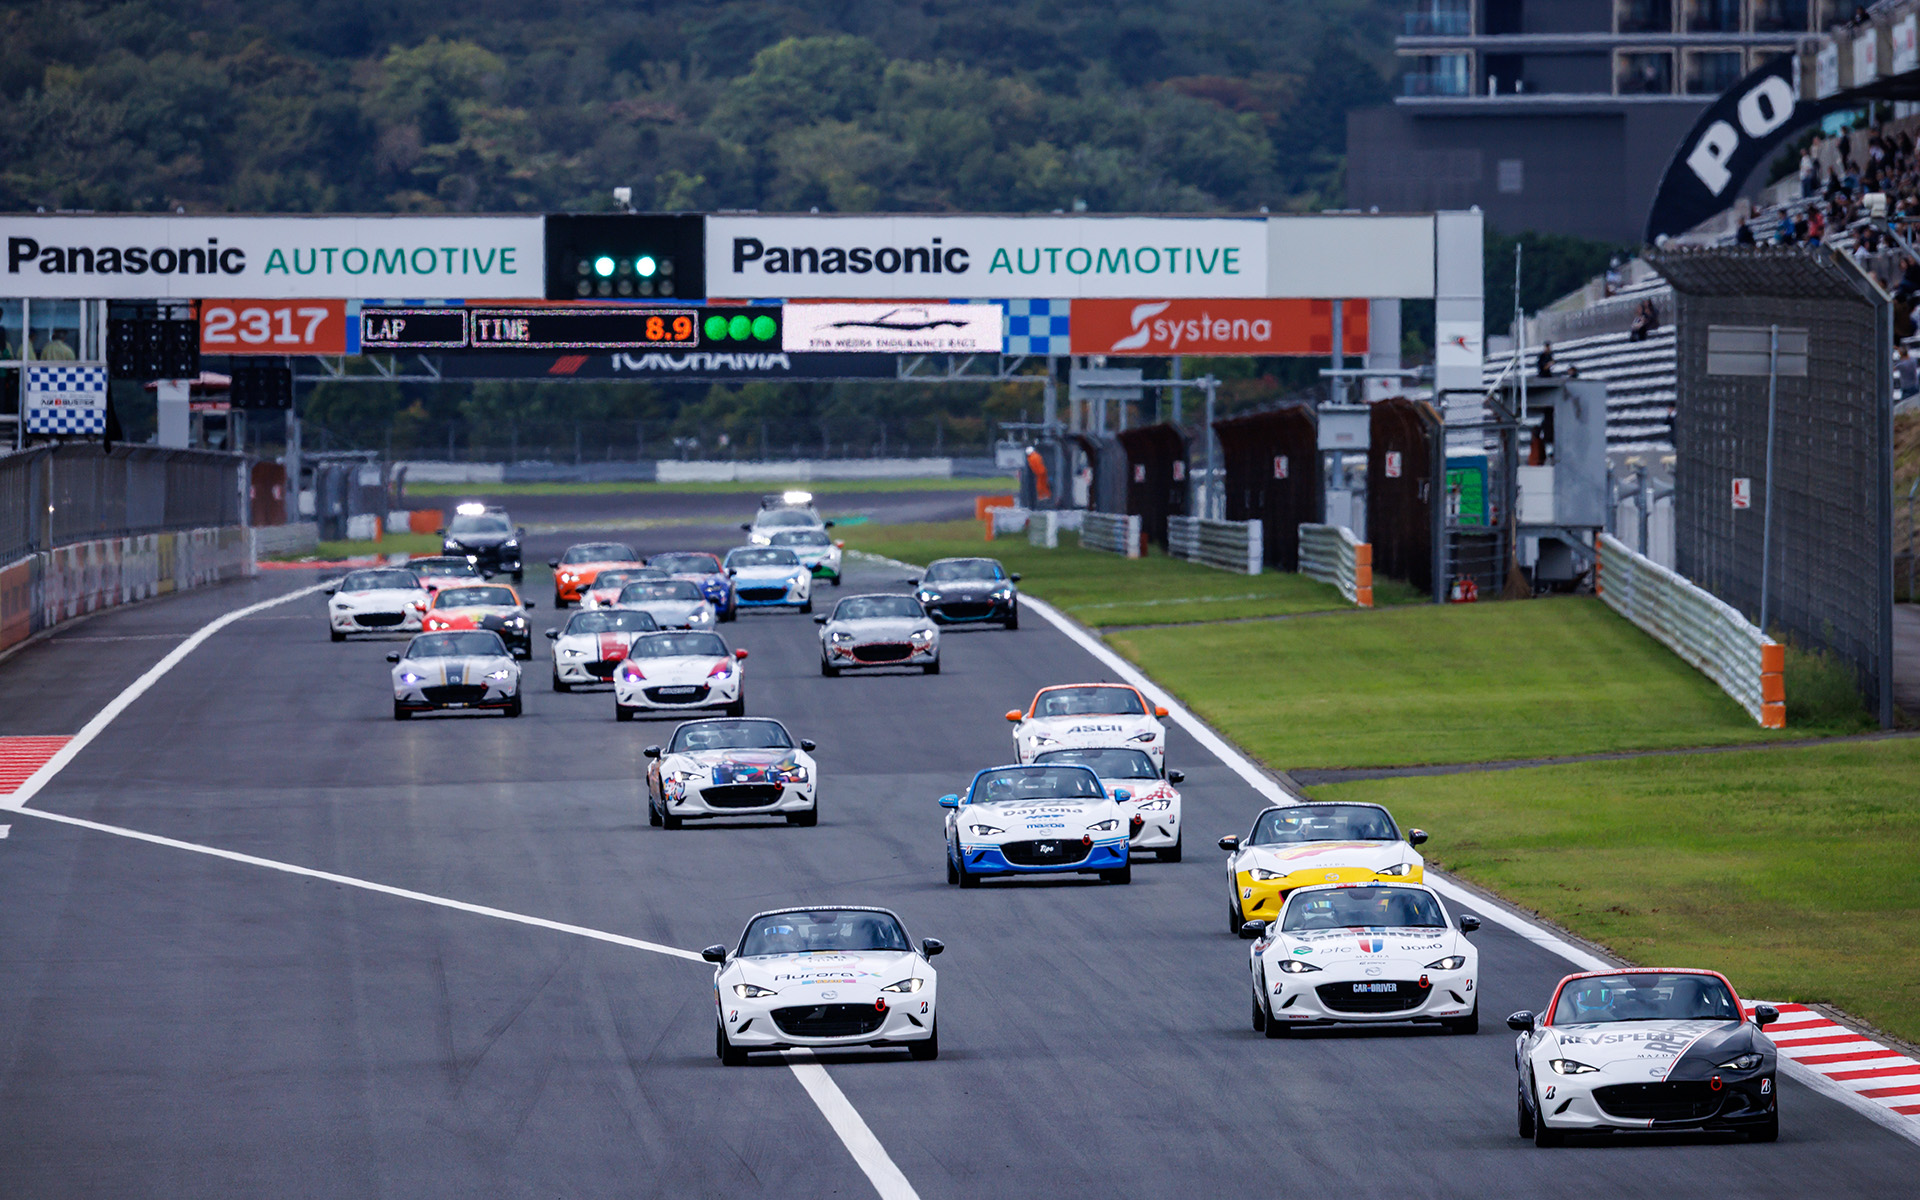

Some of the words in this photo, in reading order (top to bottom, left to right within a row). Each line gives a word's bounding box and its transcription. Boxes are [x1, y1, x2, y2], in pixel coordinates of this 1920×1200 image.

[8, 237, 247, 274] Panasonic
[264, 247, 518, 276] AUTOMOTIVE
[733, 237, 970, 274] Panasonic
[989, 246, 1241, 275] AUTOMOTIVE
[203, 307, 329, 344] 2317
[365, 317, 407, 341] LAP
[478, 317, 531, 341] TIME
[645, 316, 692, 341] 8.9
[1153, 311, 1273, 350] systena
[1067, 724, 1123, 734] ASCII
[1003, 807, 1083, 817] Daytona
